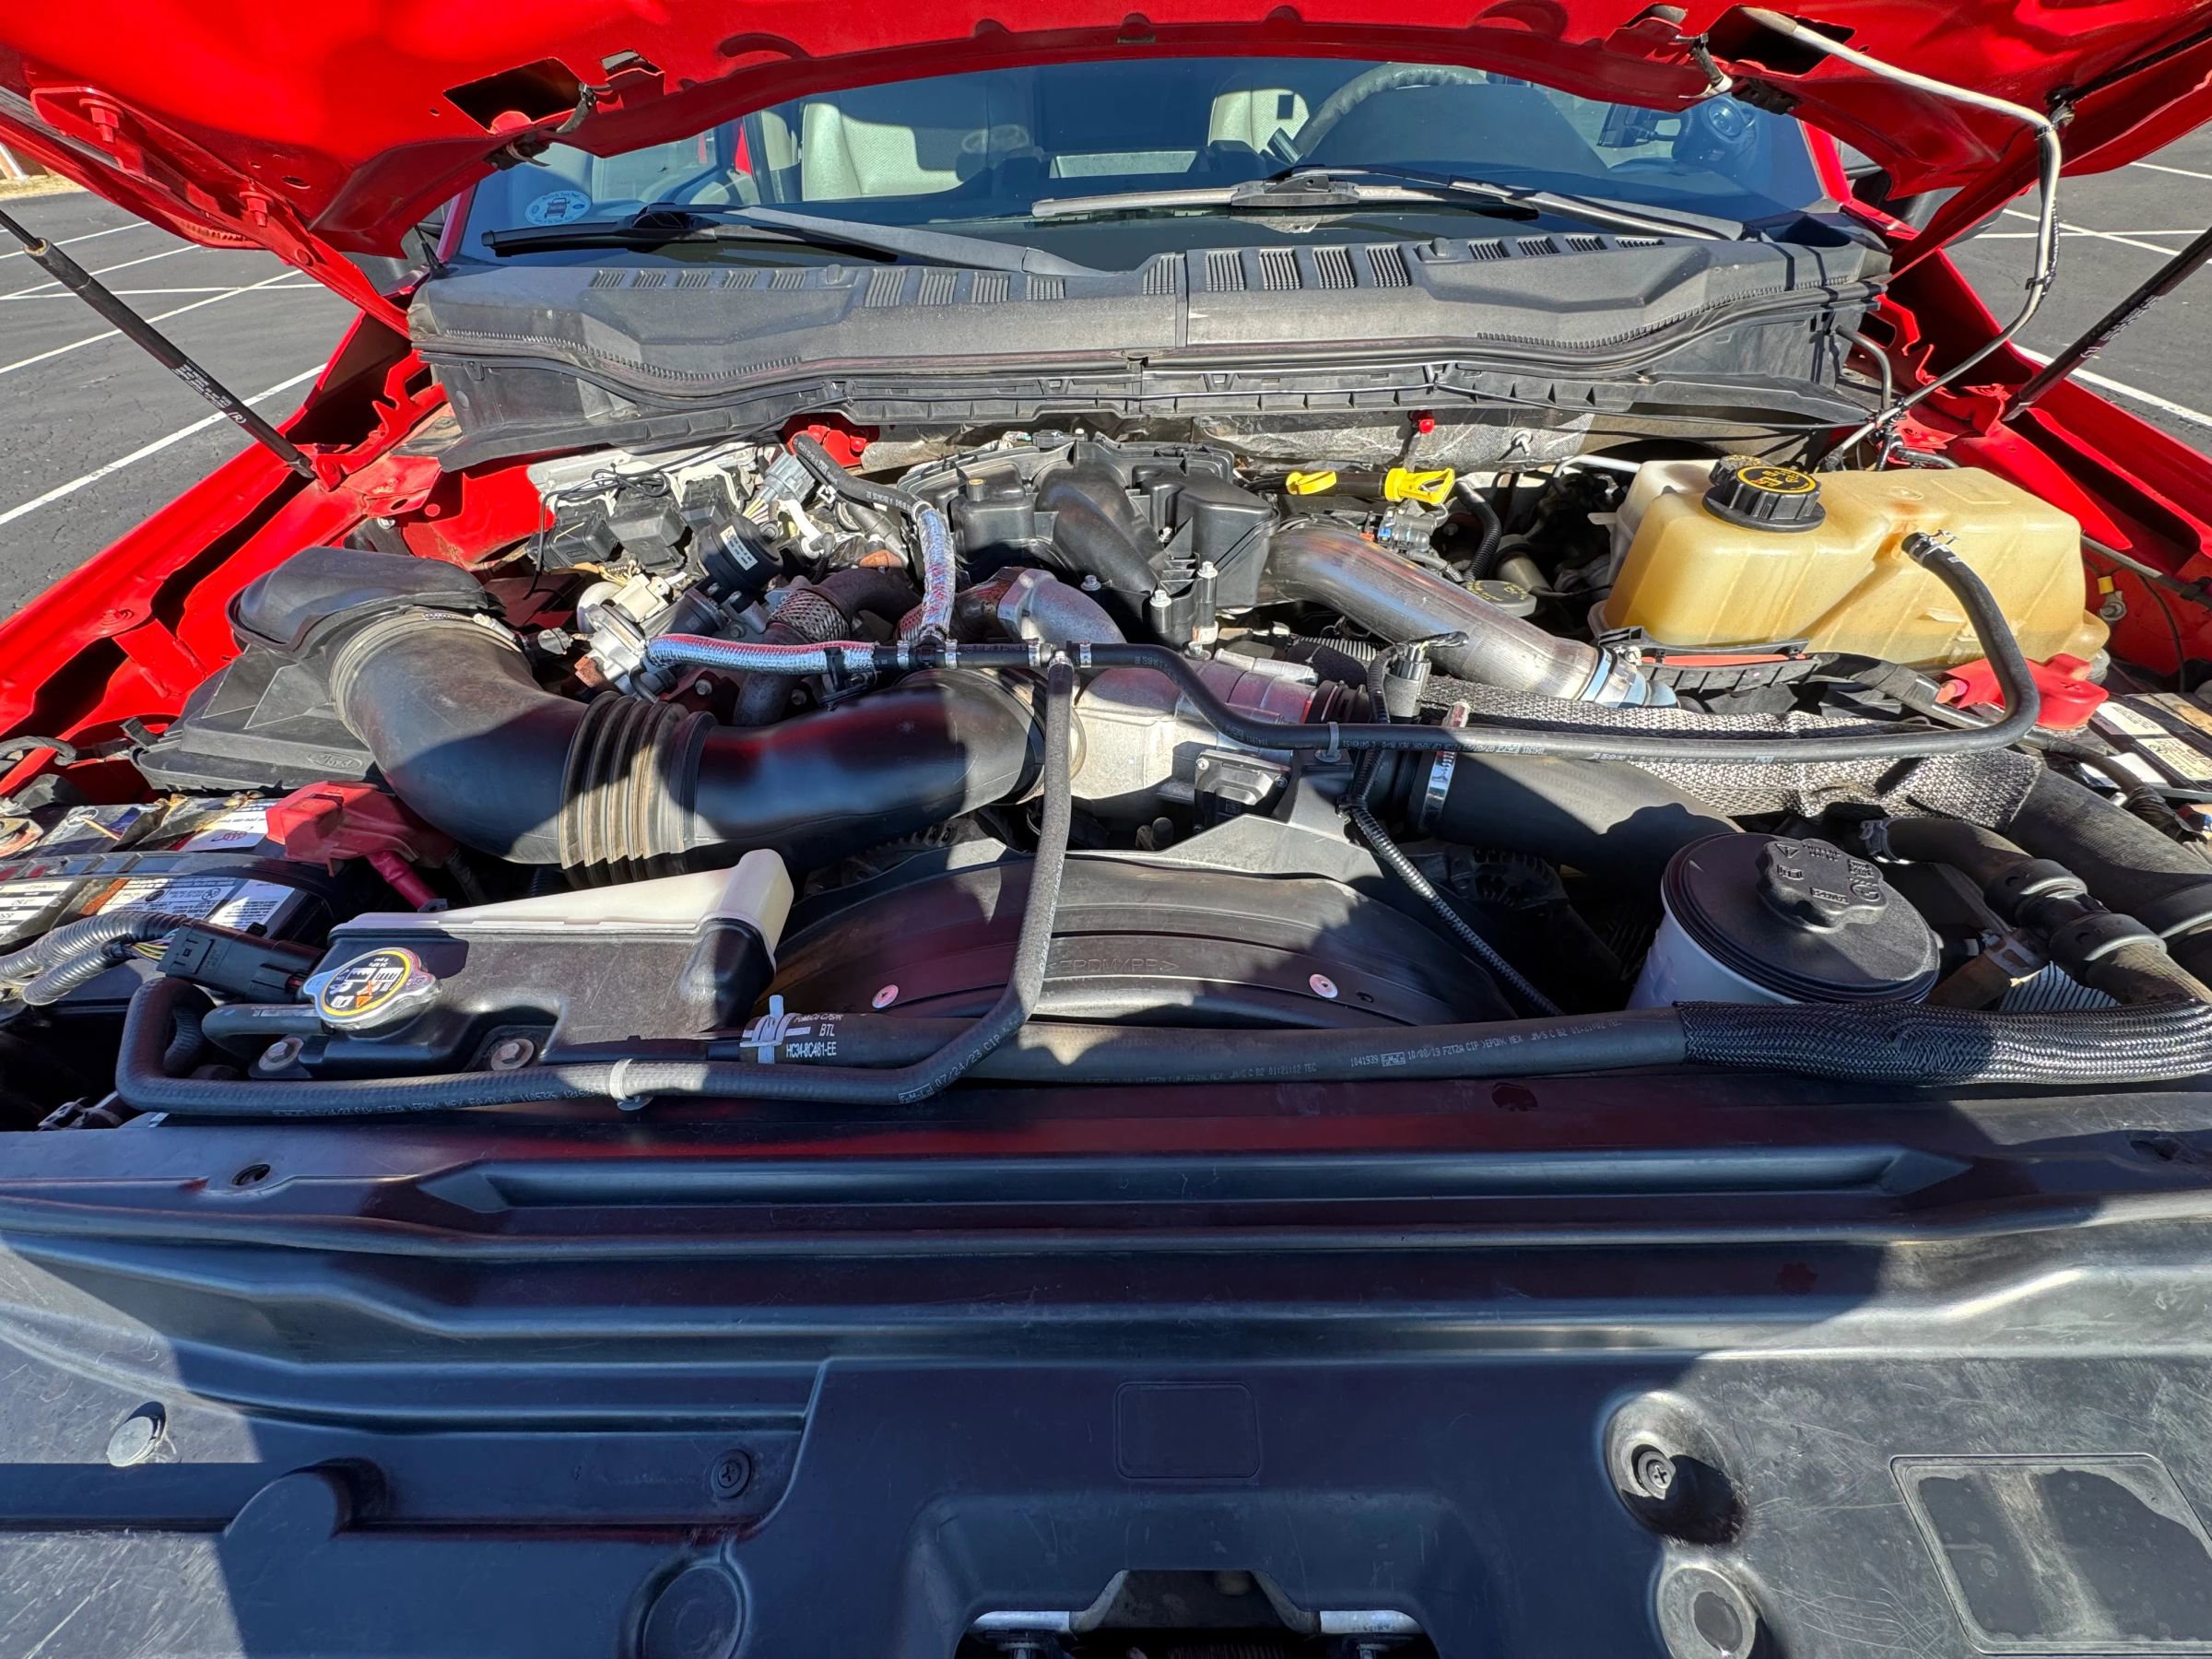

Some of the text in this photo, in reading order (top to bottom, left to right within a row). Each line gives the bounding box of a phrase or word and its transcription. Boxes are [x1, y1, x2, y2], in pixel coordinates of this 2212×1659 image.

[818, 1023, 836, 1037] BTL
[935, 1049, 983, 1088] 07/24/23
[982, 1033, 1001, 1052] CIP
[1350, 1054, 1379, 1067] 1041939
